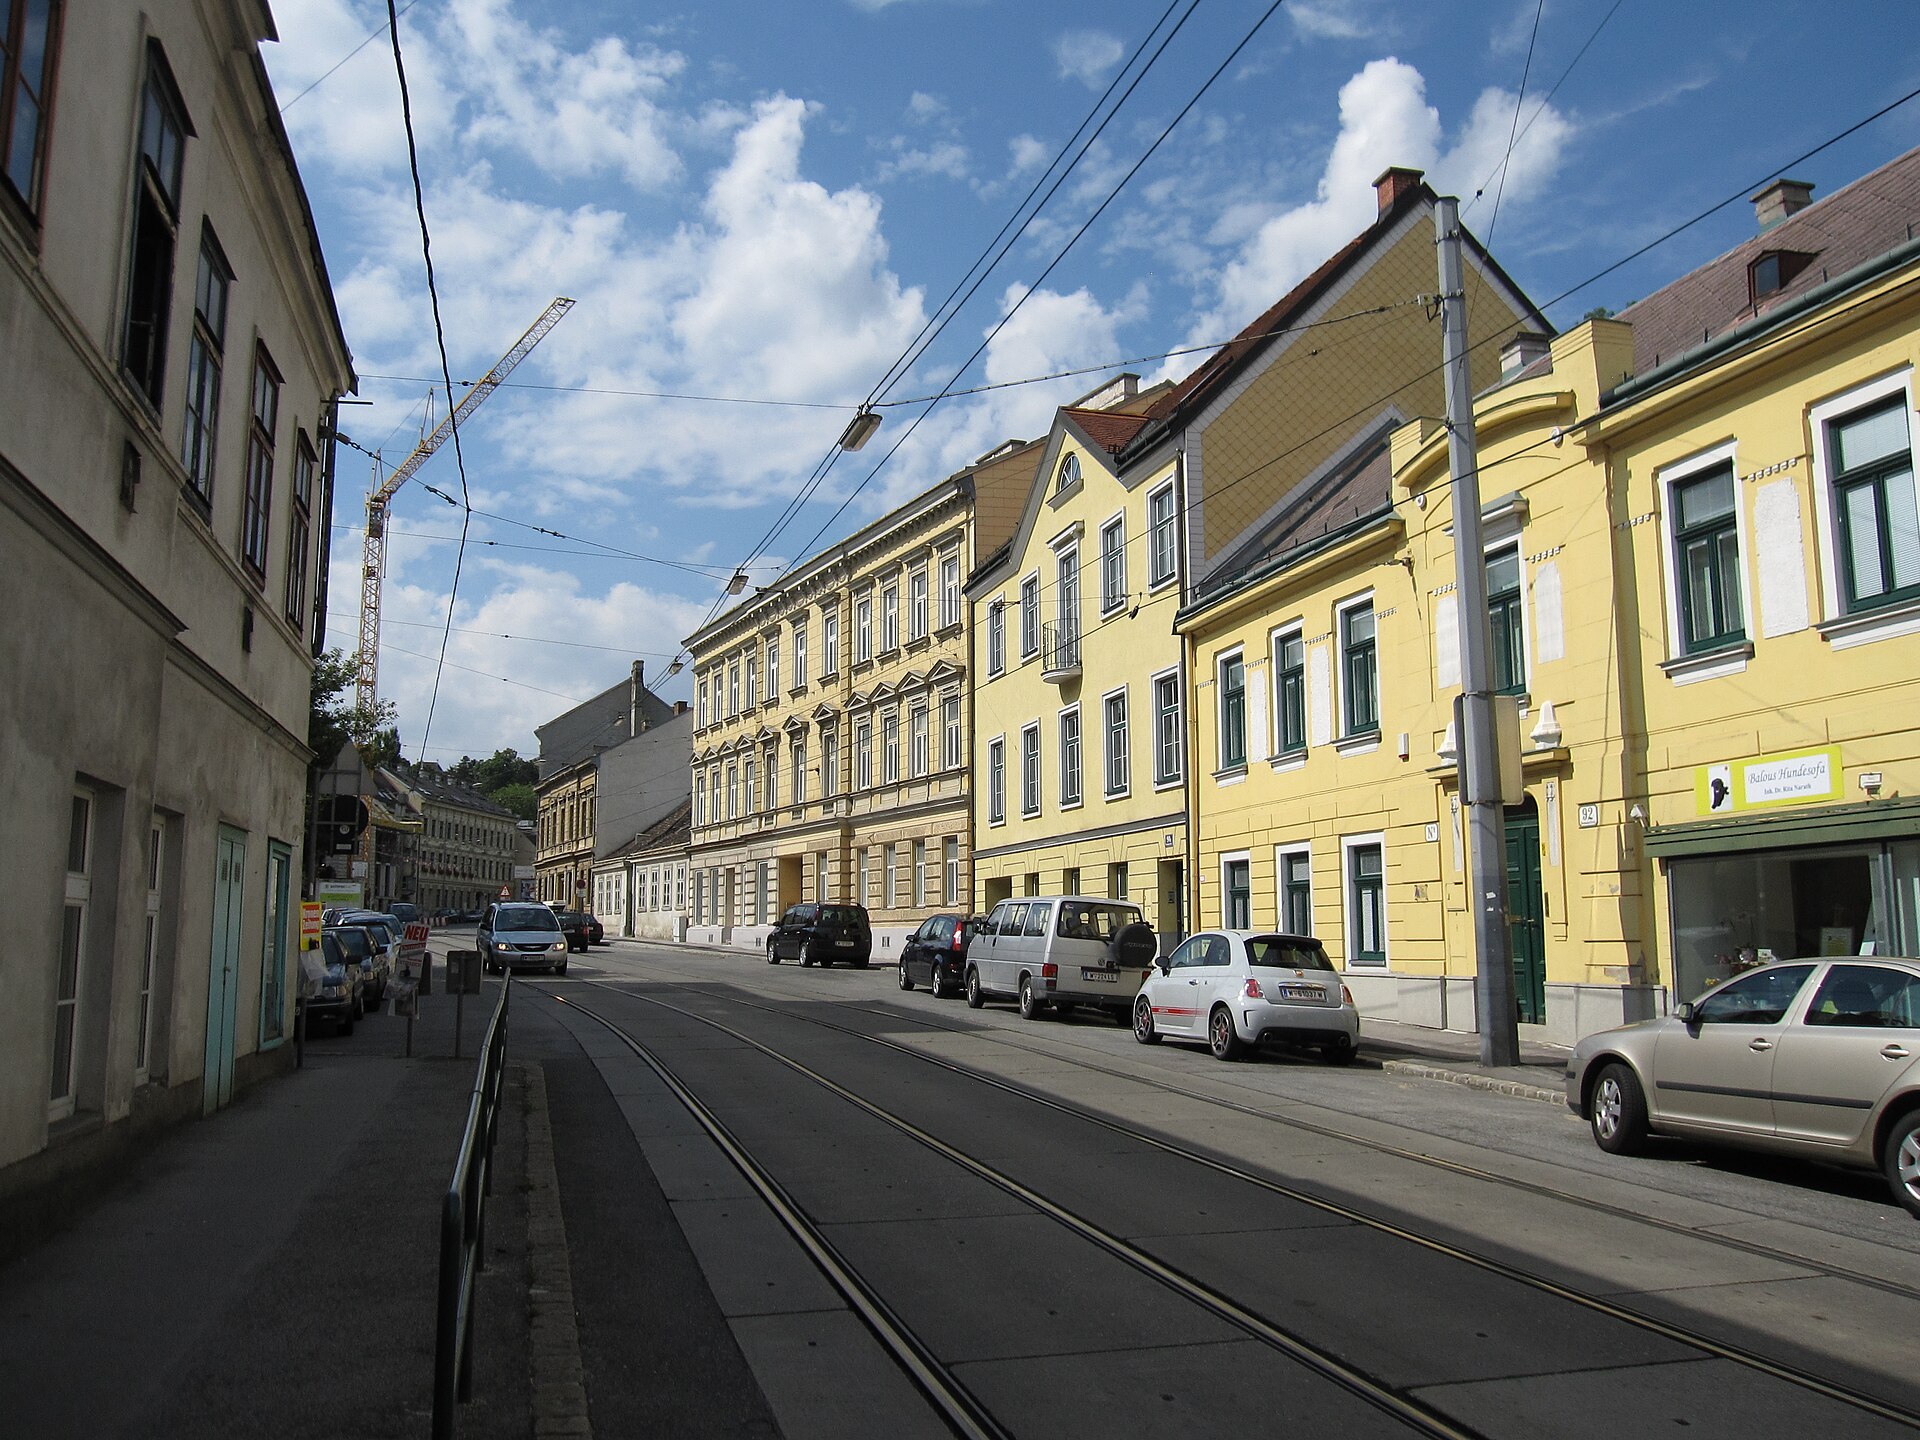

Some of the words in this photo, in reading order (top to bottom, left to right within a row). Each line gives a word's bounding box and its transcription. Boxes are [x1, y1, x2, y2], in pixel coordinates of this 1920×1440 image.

[1748, 769, 1777, 784] Balous
[1778, 761, 1826, 780] Hundesofa
[1581, 807, 1594, 821] 92
[404, 924, 430, 941] NEU
